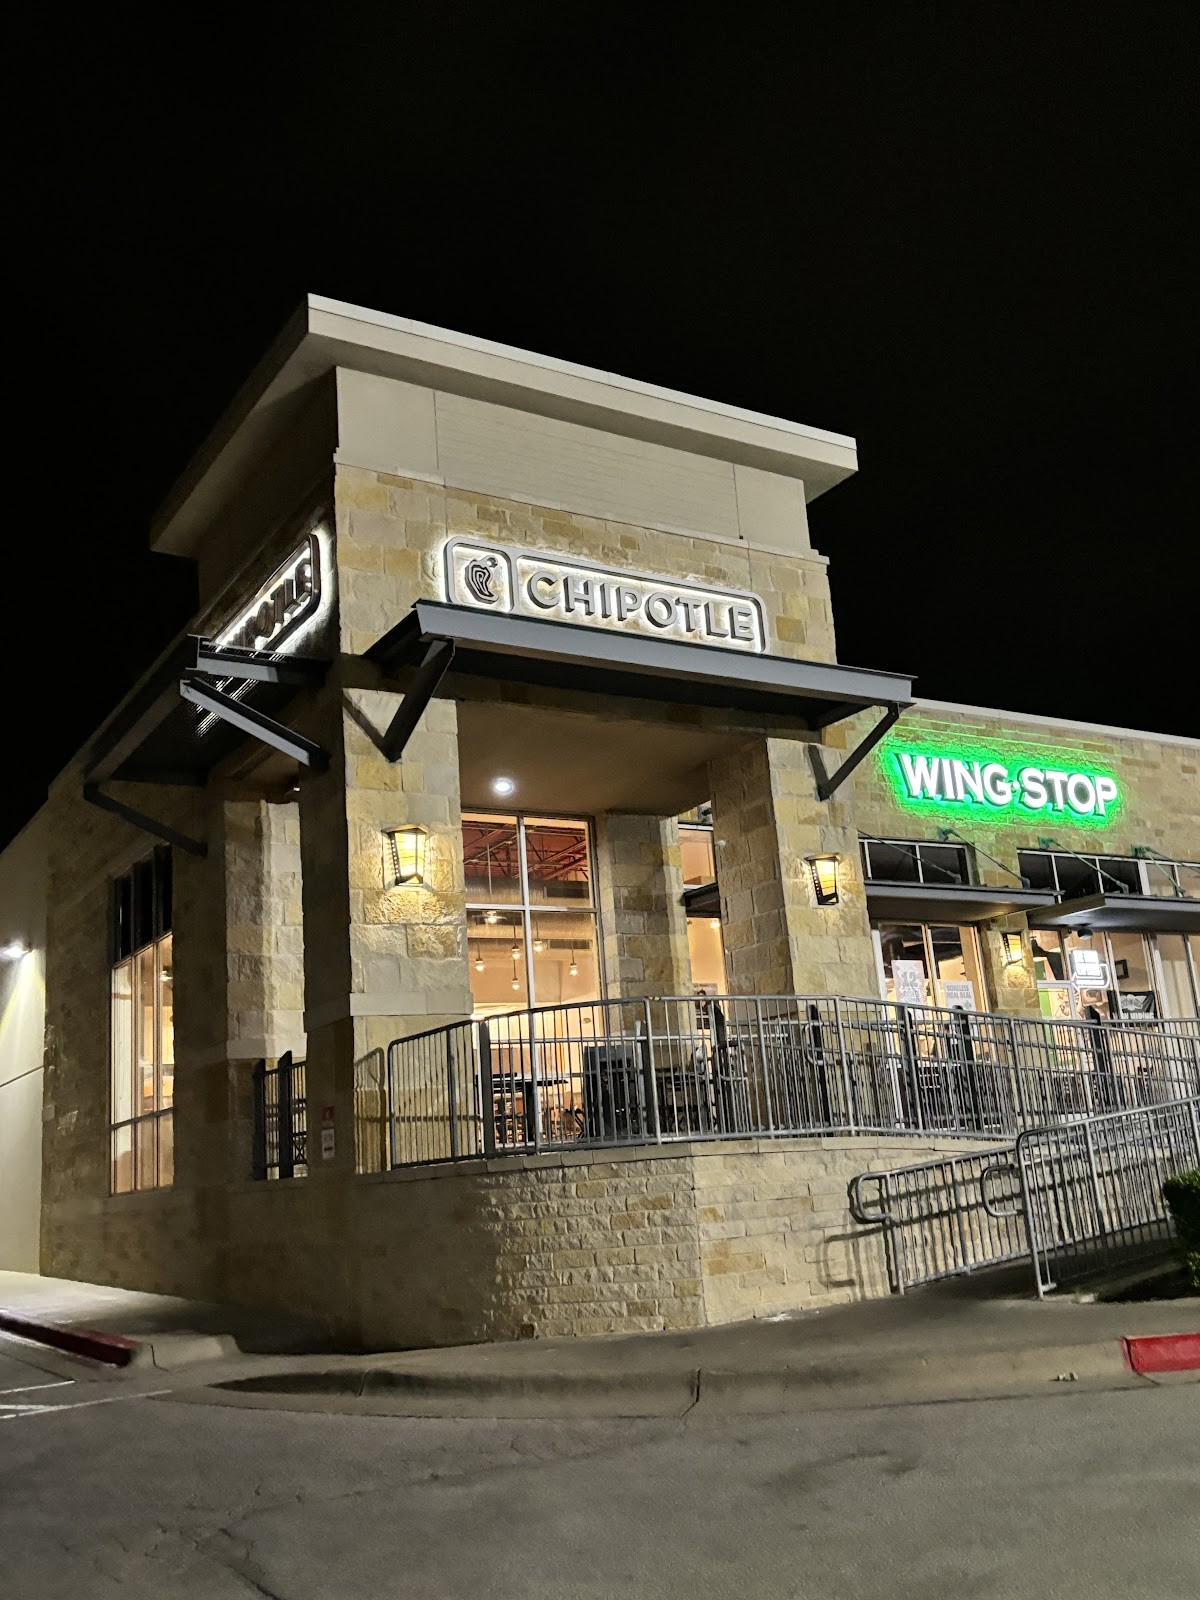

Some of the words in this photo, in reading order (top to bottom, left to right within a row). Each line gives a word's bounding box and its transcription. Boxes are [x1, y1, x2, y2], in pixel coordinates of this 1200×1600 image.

[527, 571, 754, 642] CHIPOTLE
[946, 984, 969, 992] BONELESS
[960, 991, 972, 999] DEAL
